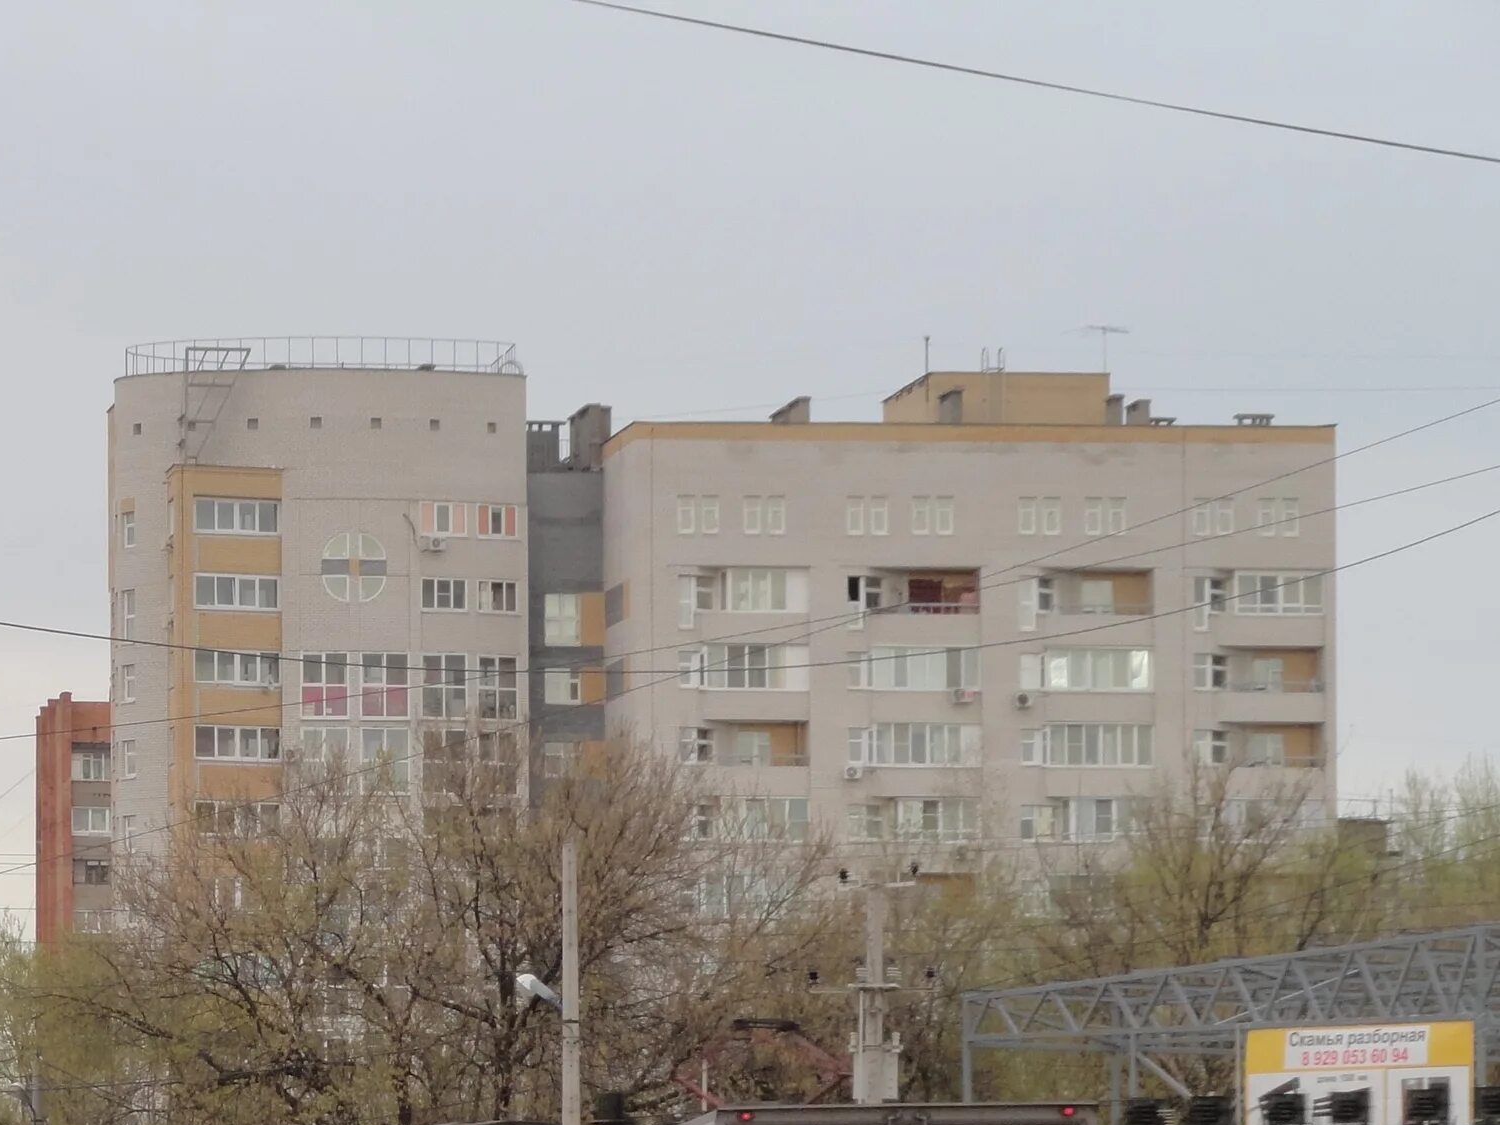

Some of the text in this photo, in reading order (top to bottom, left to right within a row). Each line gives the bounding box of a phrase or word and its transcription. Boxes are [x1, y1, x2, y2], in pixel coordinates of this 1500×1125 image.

[1289, 1028, 1426, 1047] Скамья разборная
[1301, 1047, 1409, 1066] 8 929 053 60 94
